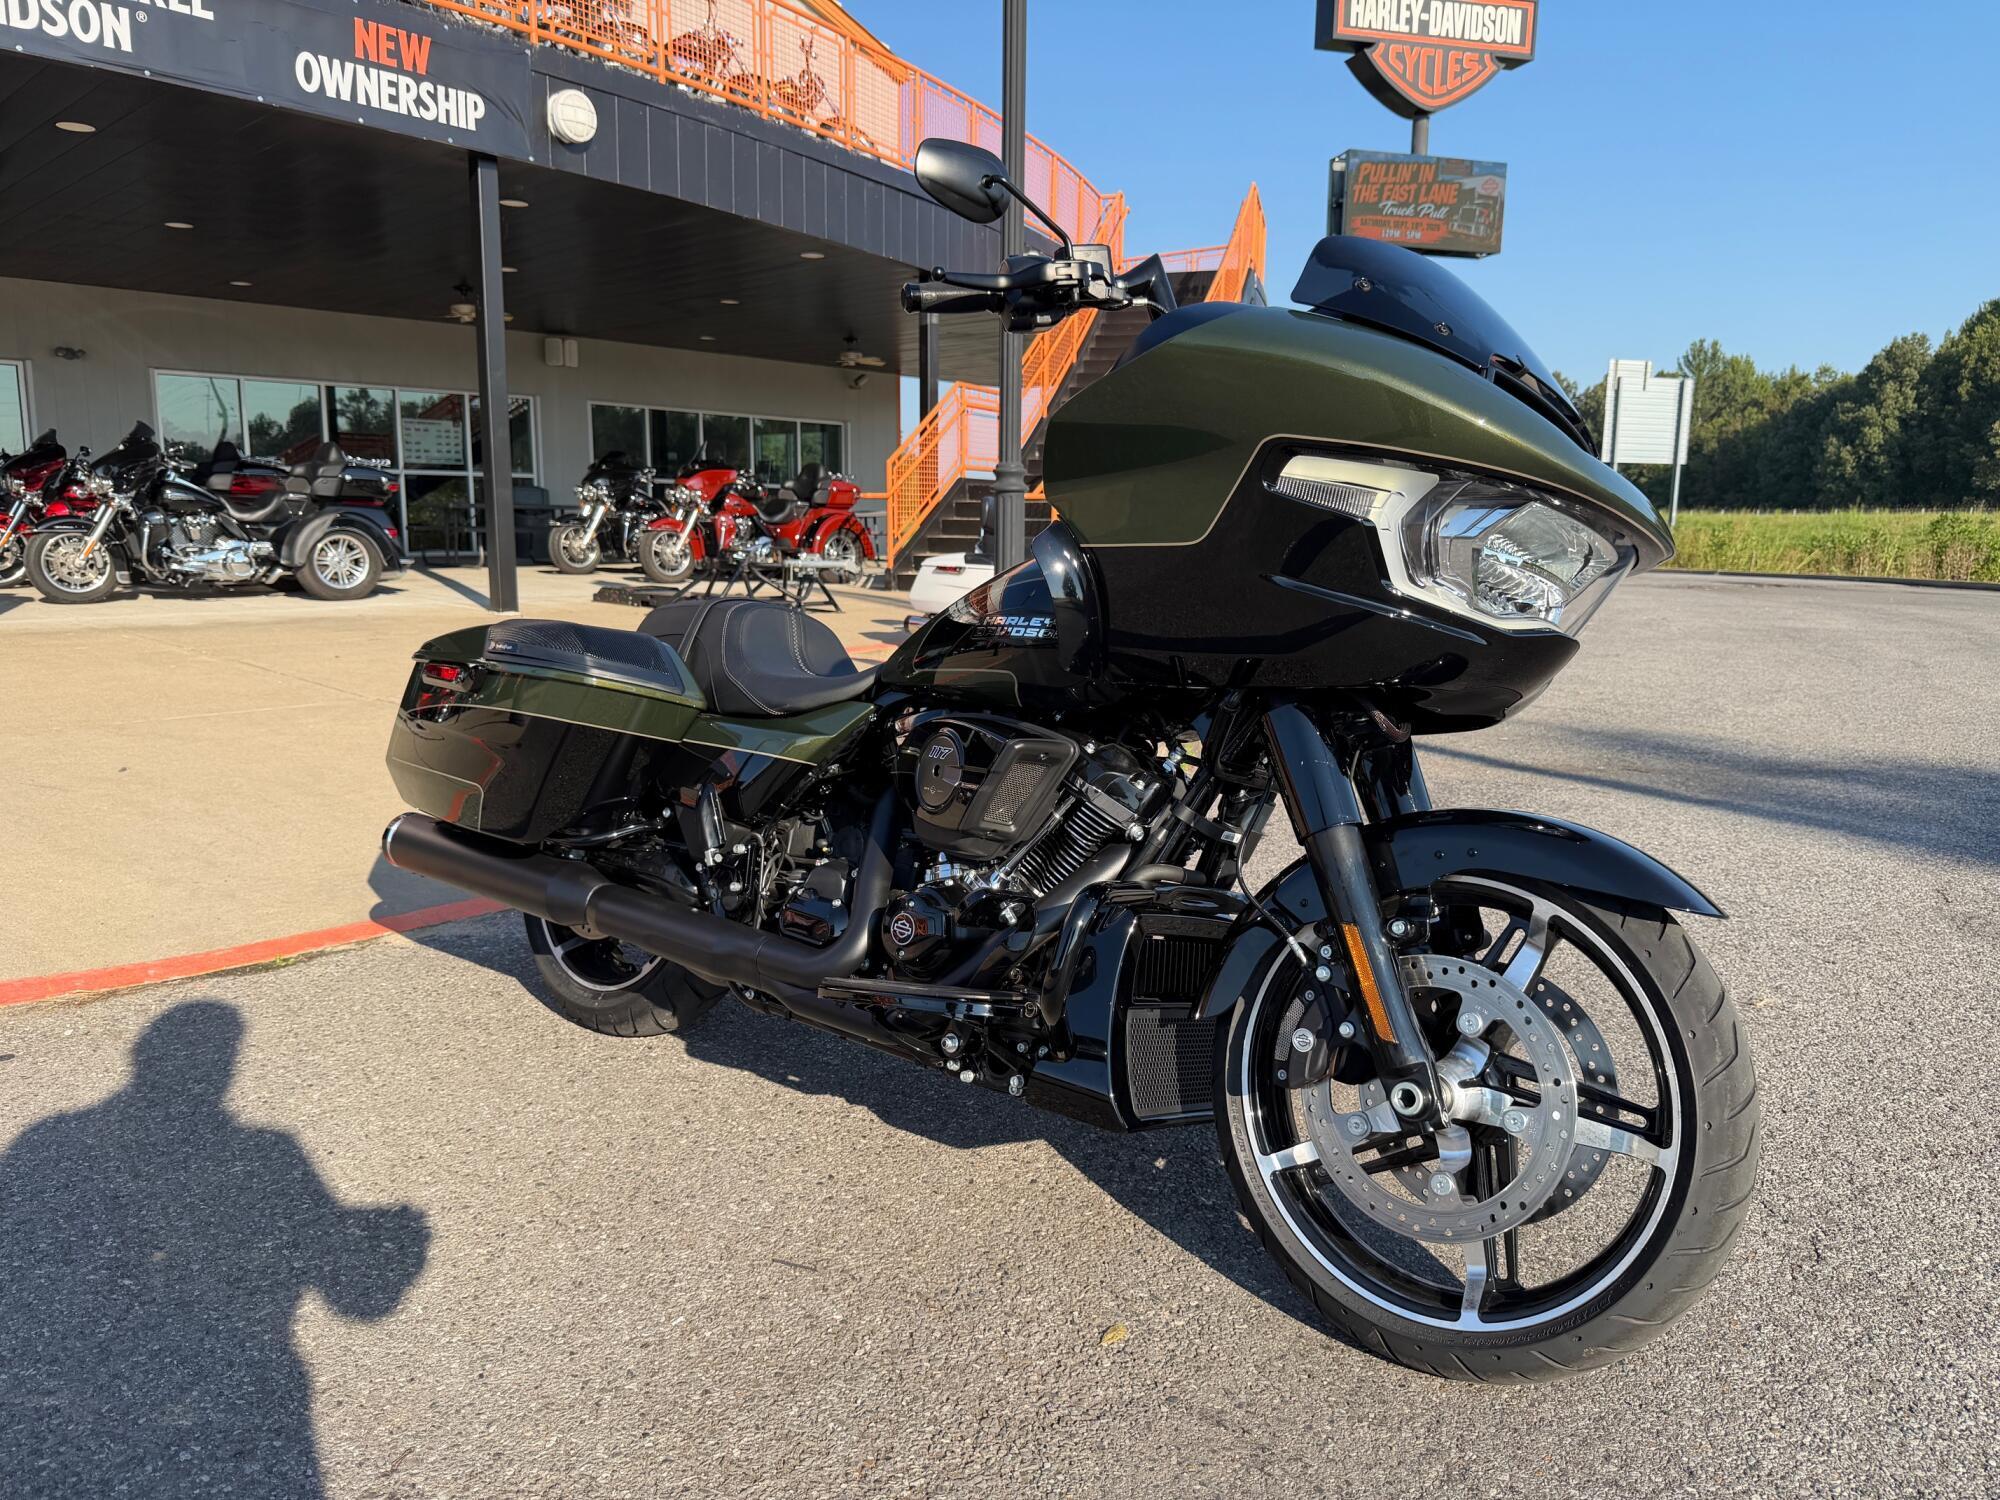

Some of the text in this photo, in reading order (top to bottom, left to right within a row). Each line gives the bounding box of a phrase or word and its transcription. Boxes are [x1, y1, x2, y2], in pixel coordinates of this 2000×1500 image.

[1350, 0, 1522, 45] HARLEY-DAVIDSON
[354, 17, 431, 75] NEW
[1388, 45, 1481, 95] CYCLES
[295, 51, 485, 131] OWNERSHIP
[1358, 162, 1436, 183] PULLIN' IN
[1353, 183, 1460, 205] THE FAST LANE
[1379, 201, 1449, 219] Truck Pull
[929, 745, 953, 759] 117
